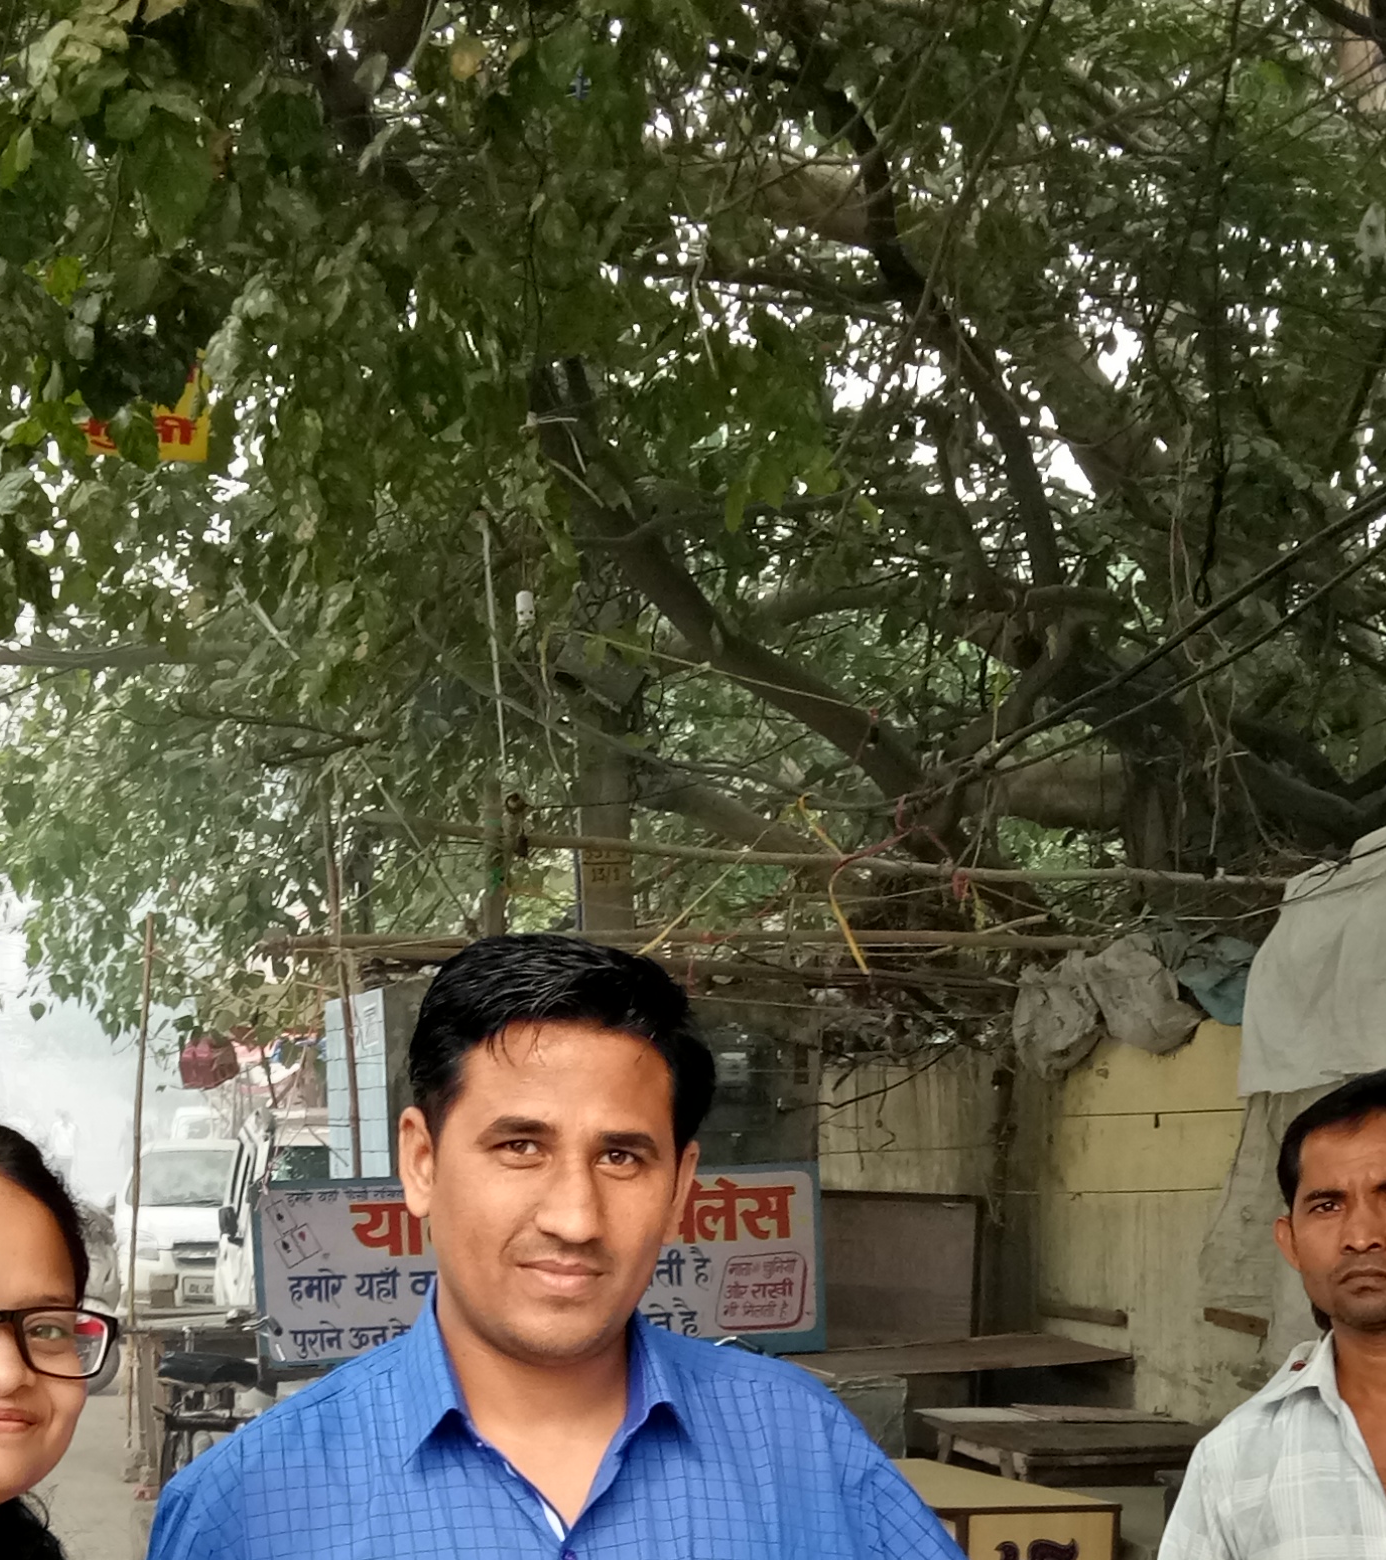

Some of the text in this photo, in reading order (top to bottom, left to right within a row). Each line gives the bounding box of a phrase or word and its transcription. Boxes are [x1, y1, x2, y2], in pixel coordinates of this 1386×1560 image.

[350, 1202, 432, 1256] या
[288, 1269, 346, 1308] हमारे
[751, 1277, 794, 1299] राखी
[290, 1321, 344, 1358] पुराने
[350, 1324, 389, 1350] ऊन
